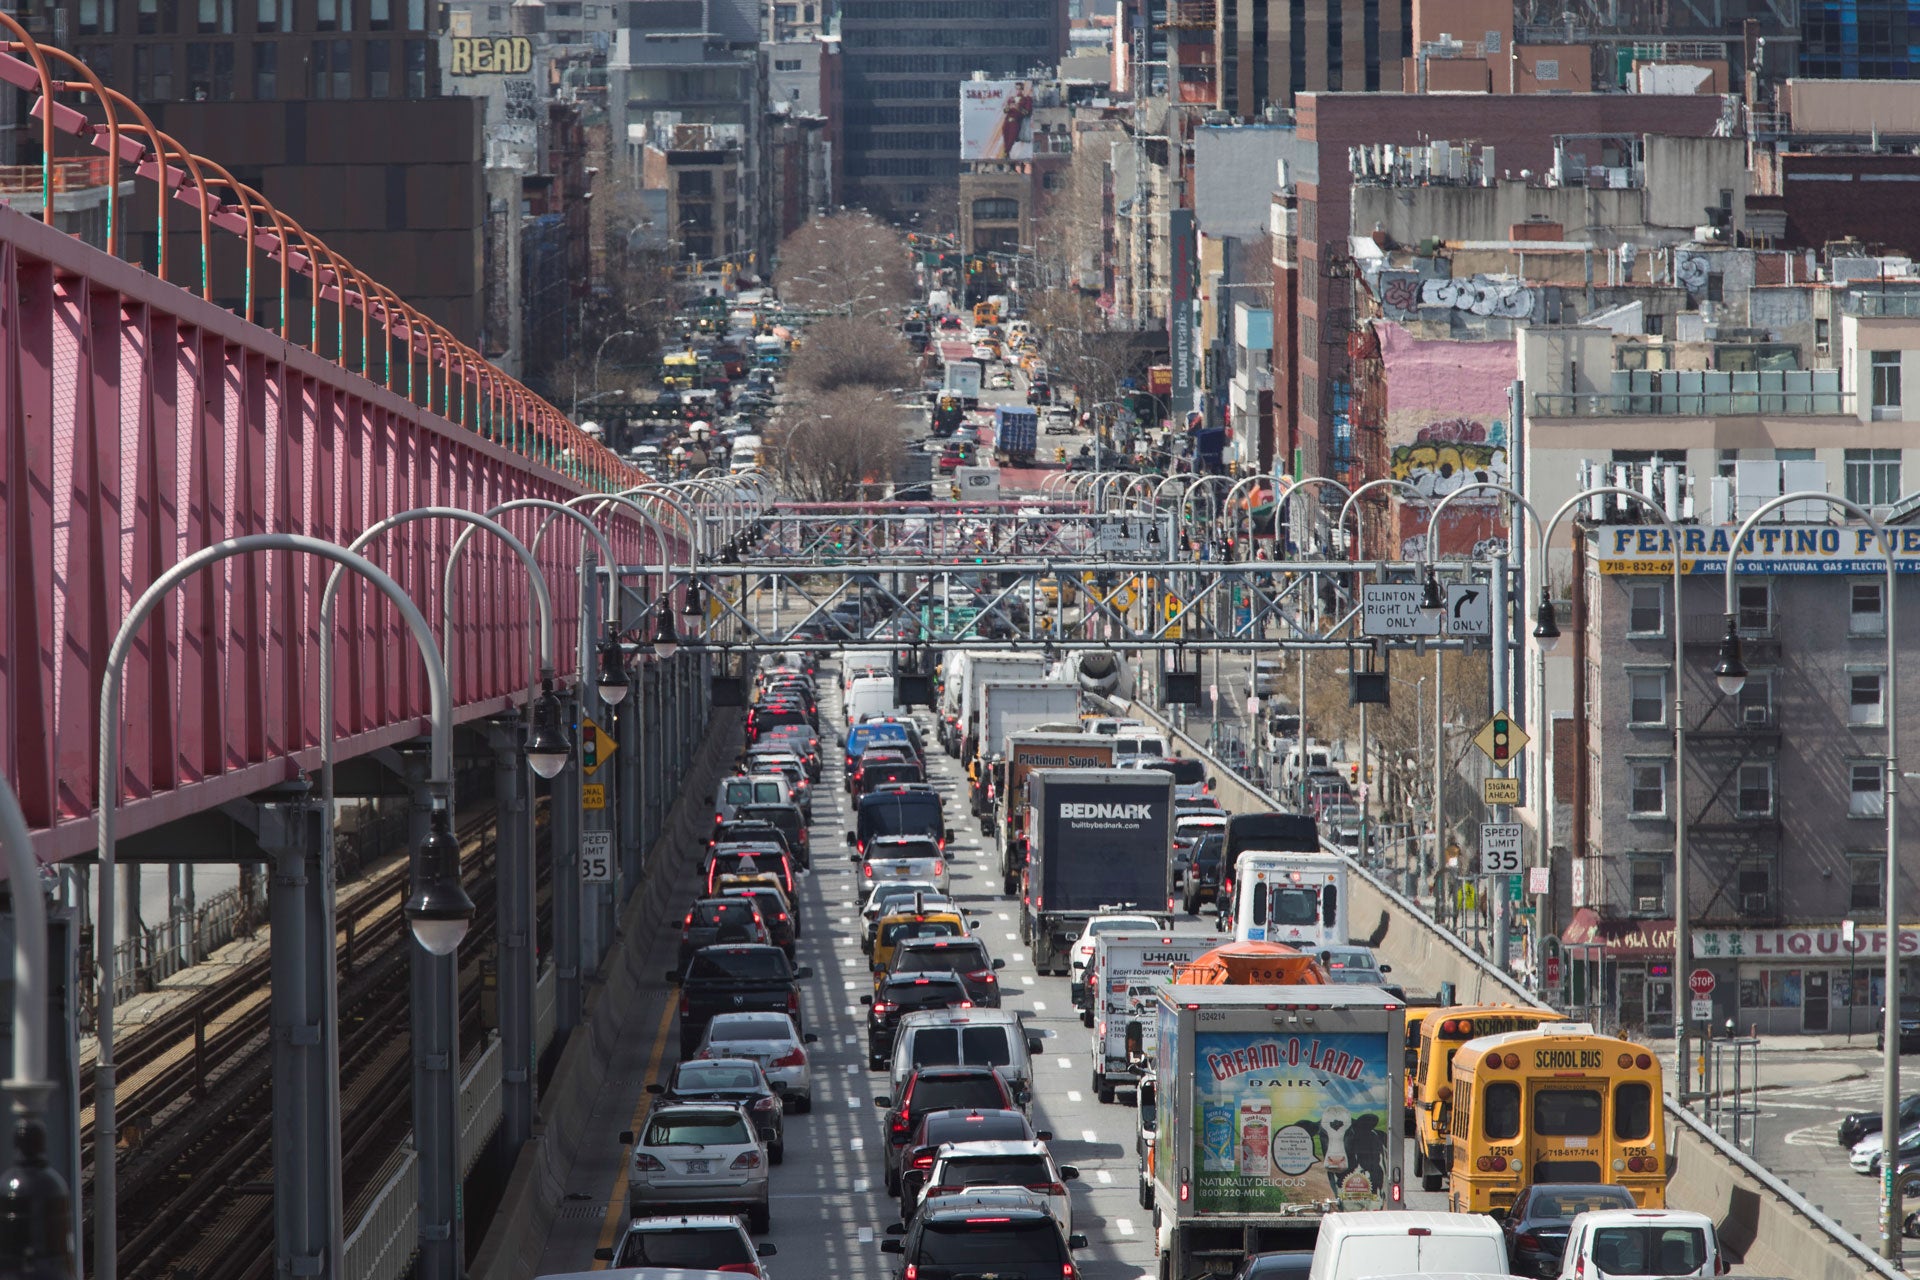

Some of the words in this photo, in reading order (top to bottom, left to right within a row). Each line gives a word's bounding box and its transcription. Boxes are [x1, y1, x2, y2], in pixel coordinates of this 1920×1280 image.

[450, 36, 532, 77] READ
[1178, 350, 1188, 388] DUANE
[1613, 528, 1840, 556] FERRANTINO
[1855, 528, 1920, 555] FUE
[1606, 562, 1689, 571] 718-832-670
[1703, 562, 1745, 571] HEATG
[1748, 562, 1764, 571] OIL
[1773, 562, 1819, 571] NATURAL
[1823, 562, 1843, 571] GAS
[1851, 562, 1905, 571] ELECTRITY
[1367, 591, 1416, 602] CLINTON
[1367, 605, 1401, 615] RIGHT
[1407, 605, 1421, 615] LA
[1386, 618, 1417, 628] ONLY
[1453, 621, 1483, 631] ONLY
[1018, 753, 1065, 767] Platinum
[1488, 782, 1516, 790] SIGNAL
[583, 788, 602, 796] GNAL
[1060, 803, 1152, 820] BEDNARK
[1071, 821, 1140, 830] builtbybednark.com
[1485, 828, 1519, 838] SPEED
[583, 835, 608, 844] PEED
[1488, 839, 1516, 848] LIMIT
[584, 846, 605, 855] IMIT
[1487, 851, 1519, 870] 35
[583, 859, 607, 877] 35
[1606, 931, 1621, 948] LA
[1755, 932, 1919, 954] LIQUORS
[1143, 952, 1191, 962] U-HAUL
[1691, 976, 1713, 987] STOP
[1198, 1013, 1226, 1021] 1524214
[1476, 1019, 1513, 1036] SCHOOL
[1517, 1019, 1539, 1031] BUS
[1535, 1050, 1579, 1068] SCHOOL
[1580, 1050, 1601, 1068] BUS
[1249, 1079, 1331, 1087] DAIRY
[1488, 1146, 1514, 1156] 1256
[1622, 1146, 1647, 1157] 1256
[1199, 1177, 1254, 1187] NATURALLY
[1255, 1177, 1306, 1187] DELICIOUS
[1199, 1188, 1222, 1197] (800)
[1224, 1188, 1266, 1197] 220-MILK
